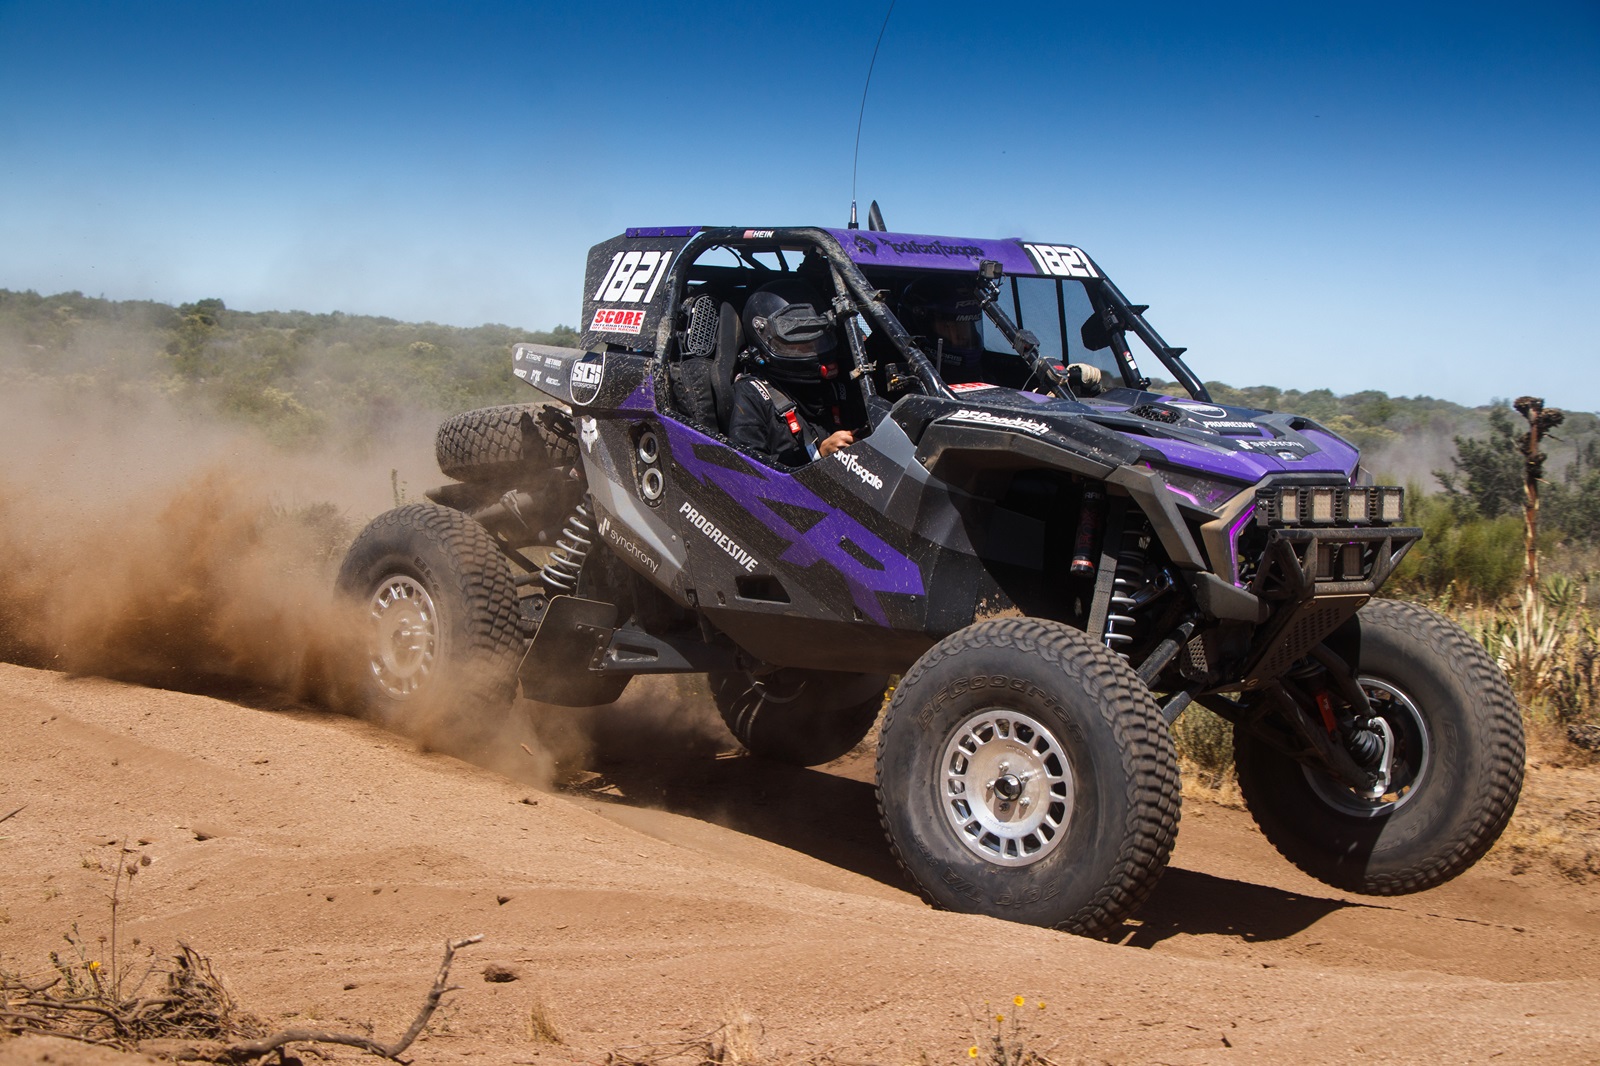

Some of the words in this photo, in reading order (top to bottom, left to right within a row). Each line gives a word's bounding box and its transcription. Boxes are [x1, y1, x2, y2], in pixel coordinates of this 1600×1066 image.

[752, 230, 775, 239] HEIN
[1023, 244, 1100, 278] 1821
[592, 251, 673, 304] 1821
[594, 310, 644, 326] SCORE
[956, 314, 982, 322] IMPAC
[952, 410, 1050, 435] BFGoodrich
[1203, 421, 1258, 429] PROGRESSIVE
[679, 502, 759, 573] PROGRESSIVE
[610, 529, 659, 573] synchrony
